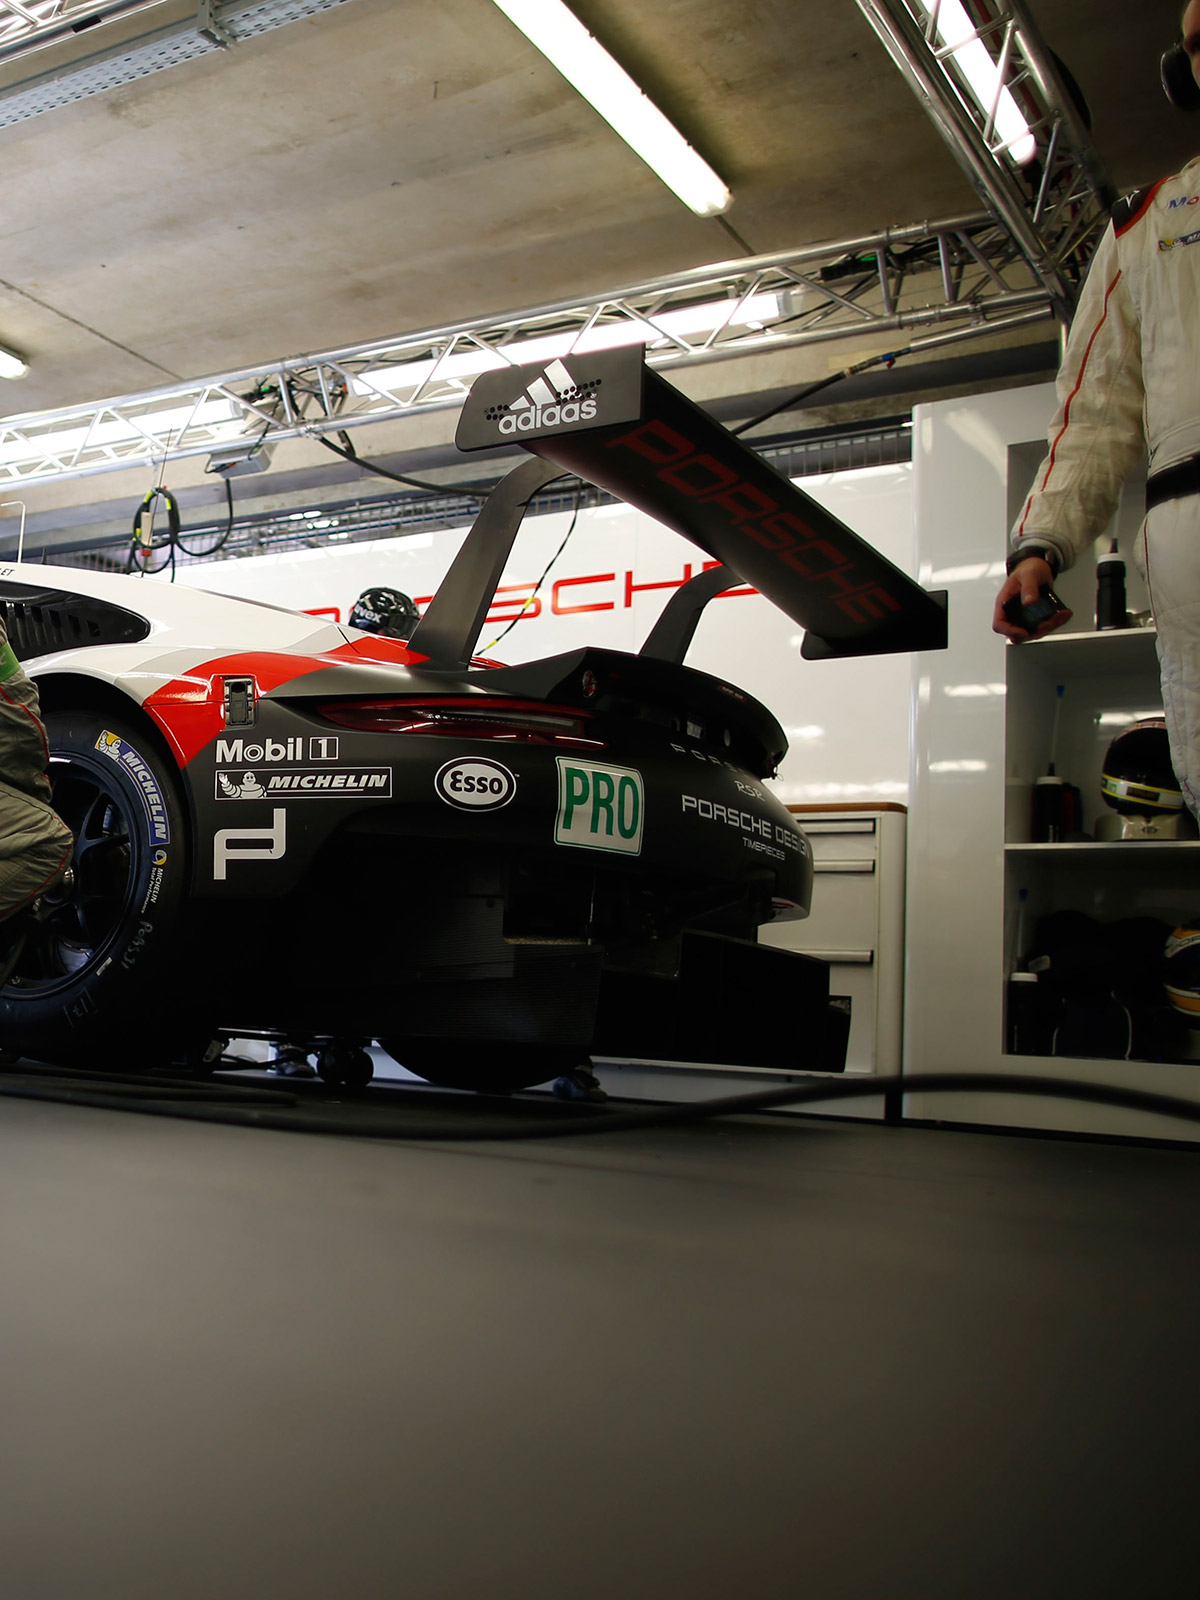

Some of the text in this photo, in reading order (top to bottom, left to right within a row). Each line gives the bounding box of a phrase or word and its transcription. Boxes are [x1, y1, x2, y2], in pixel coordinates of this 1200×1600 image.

[499, 400, 597, 434] adidas
[604, 419, 902, 624] PORSCHE
[355, 603, 382, 623] uvex
[216, 738, 302, 762] Mobil
[122, 750, 167, 841] MICHELIN
[267, 774, 387, 788] MICHELIN
[562, 766, 639, 840] PRO
[682, 794, 772, 839] PORSCHE
[742, 836, 786, 861] TIMEPIECES
[150, 868, 164, 903] MICHELIN
